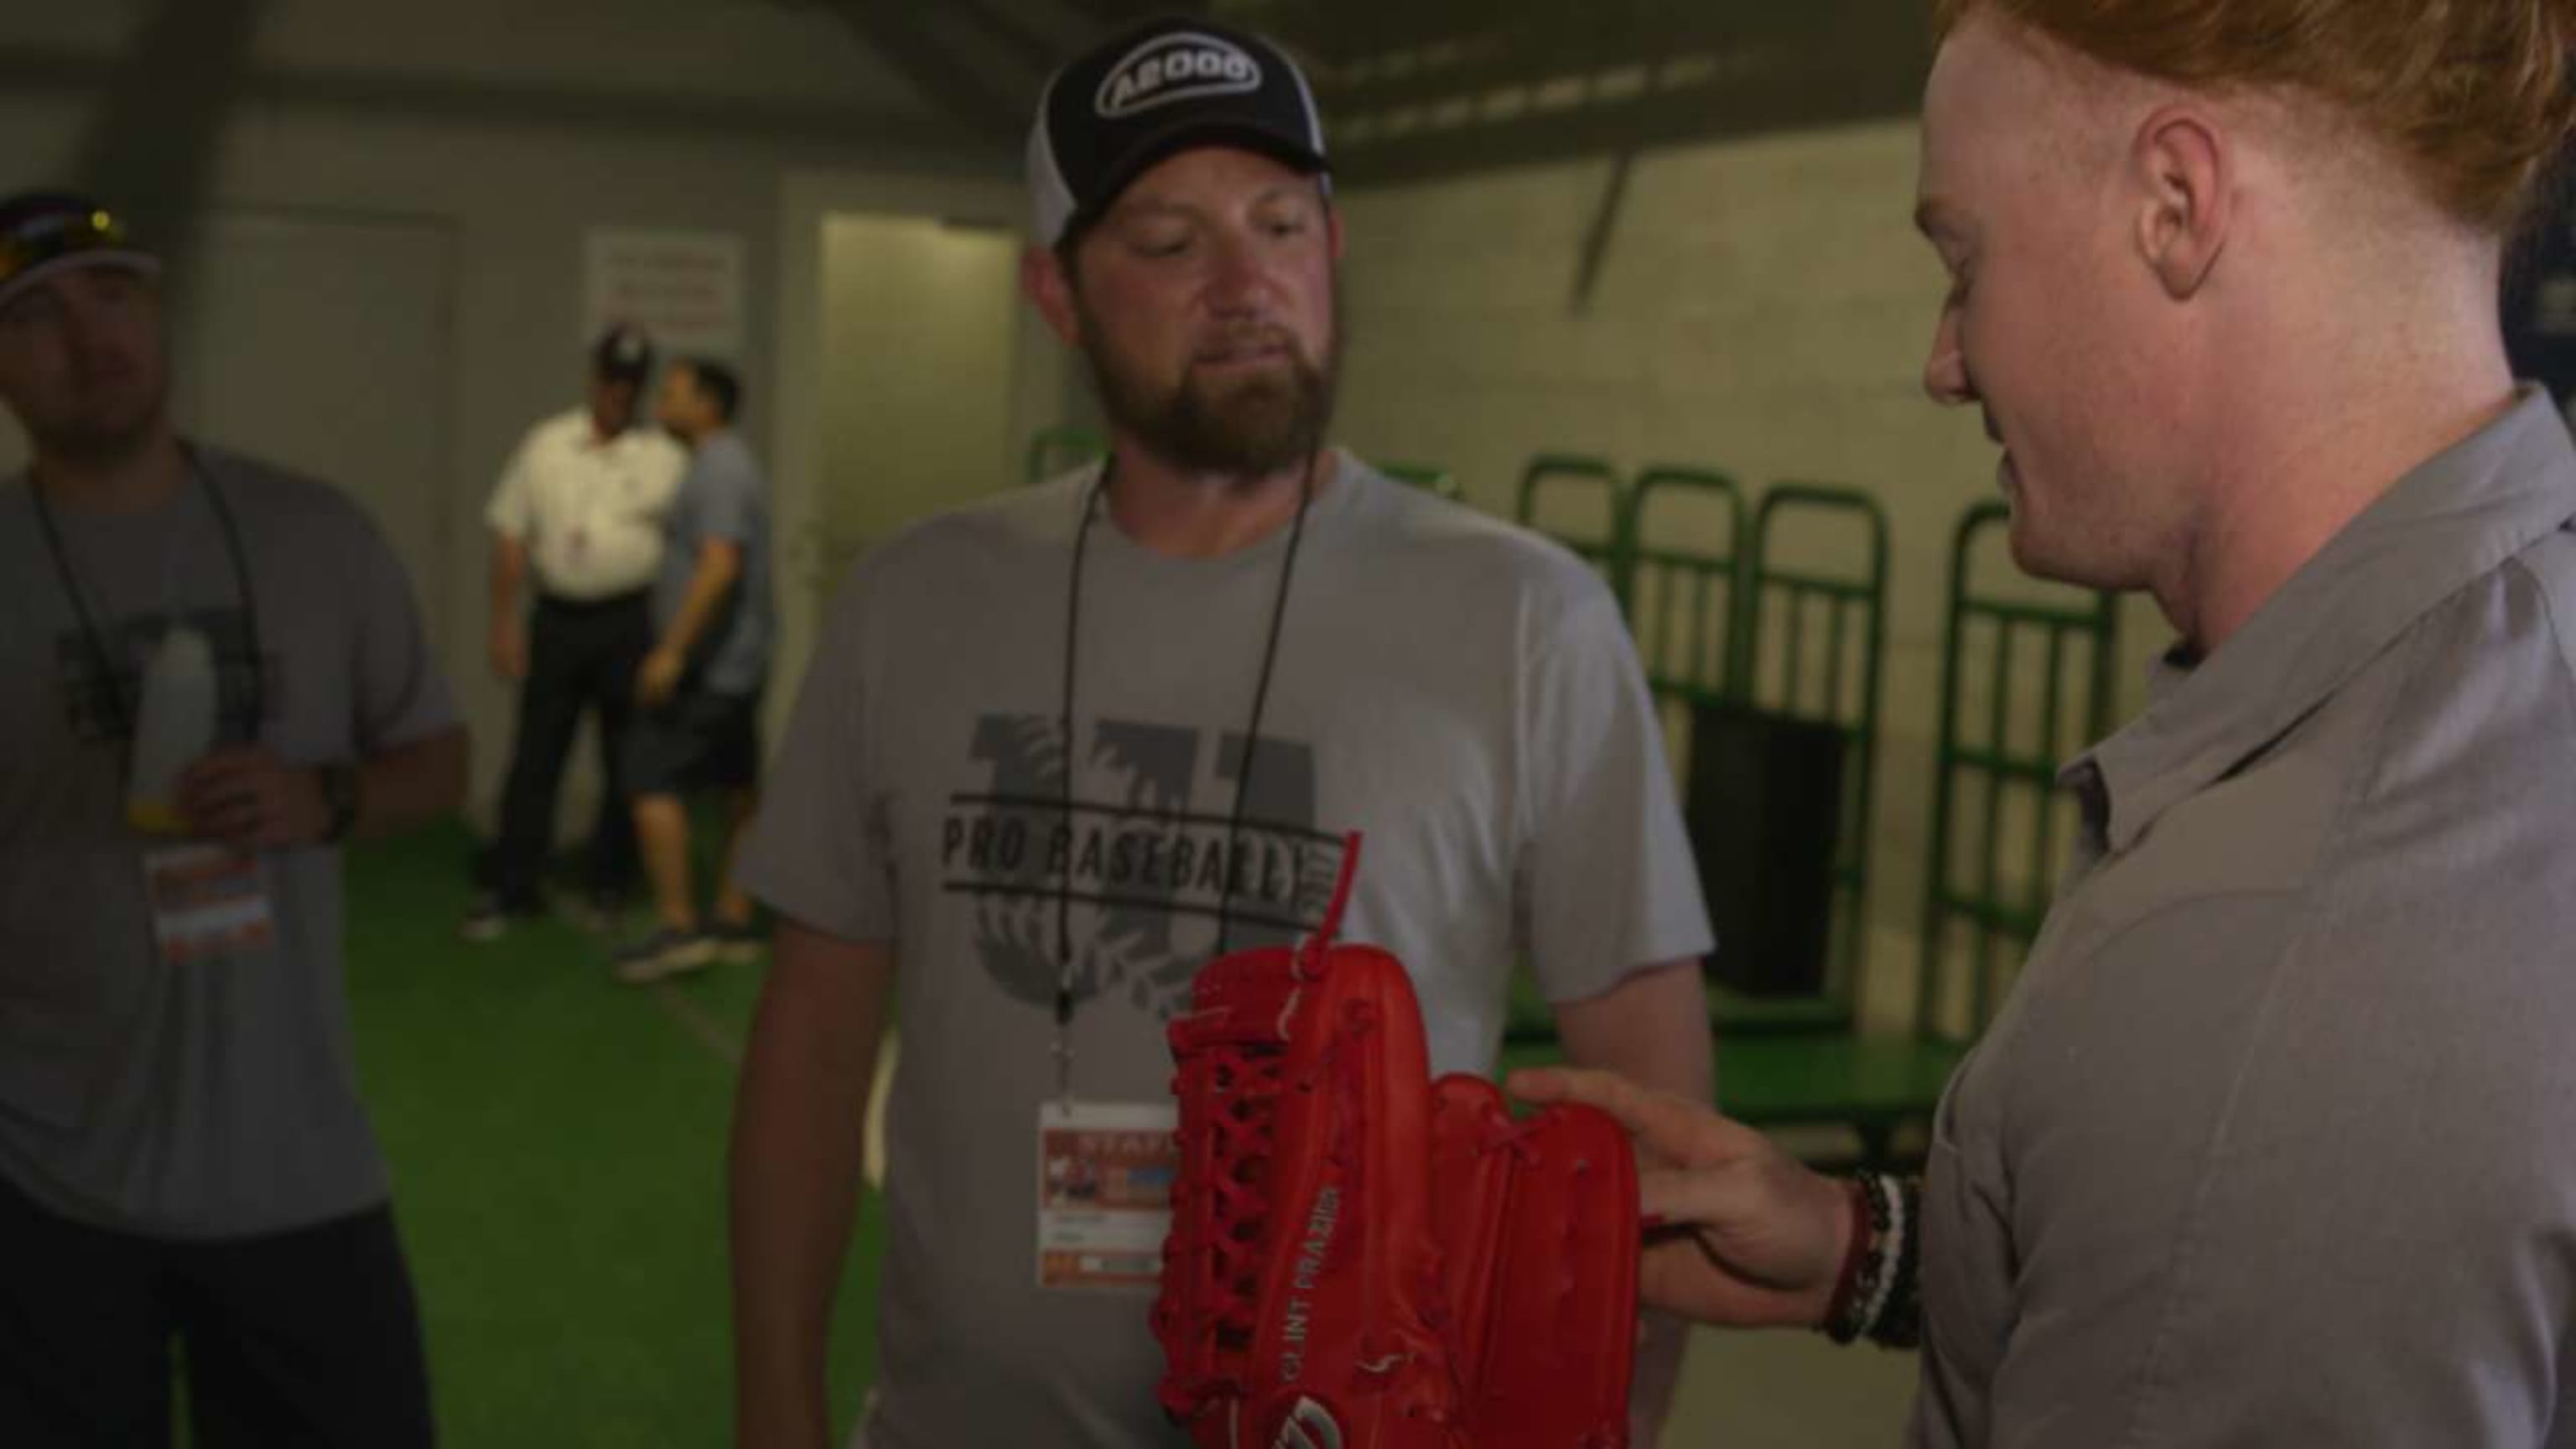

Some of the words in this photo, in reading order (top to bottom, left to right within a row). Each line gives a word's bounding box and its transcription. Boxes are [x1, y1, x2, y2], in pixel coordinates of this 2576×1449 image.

[1109, 49, 1249, 107] A2000
[941, 816, 1028, 872] PRO
[1047, 823, 1282, 901] BASEBALL
